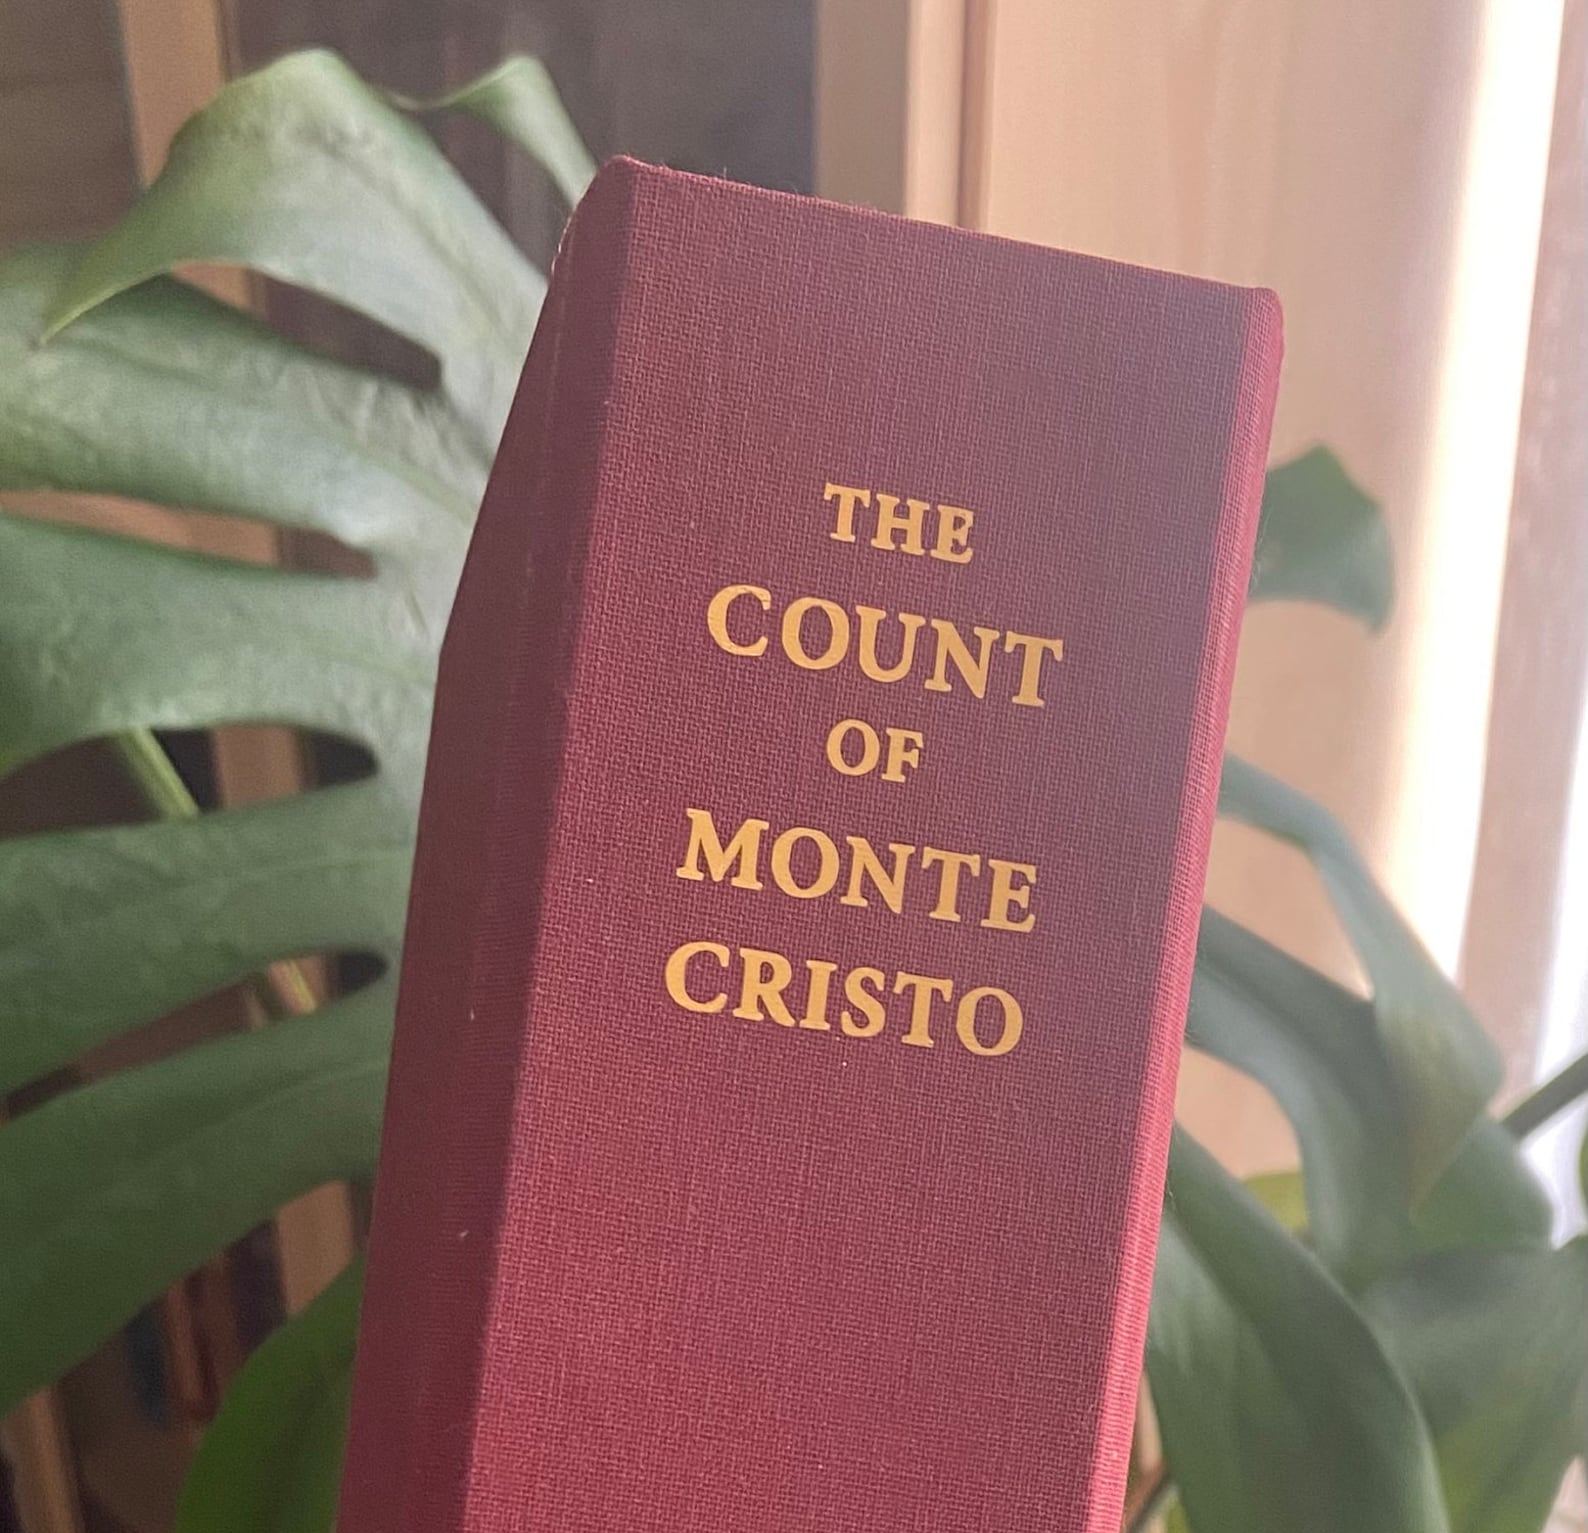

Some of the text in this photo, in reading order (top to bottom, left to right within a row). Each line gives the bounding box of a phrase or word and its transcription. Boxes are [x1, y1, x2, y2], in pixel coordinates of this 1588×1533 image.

[825, 484, 974, 562] THE
[708, 585, 1063, 706] COUNT
[826, 720, 923, 782] OF
[677, 809, 1037, 932] MONTE
[665, 941, 1023, 1056] CRISTO
